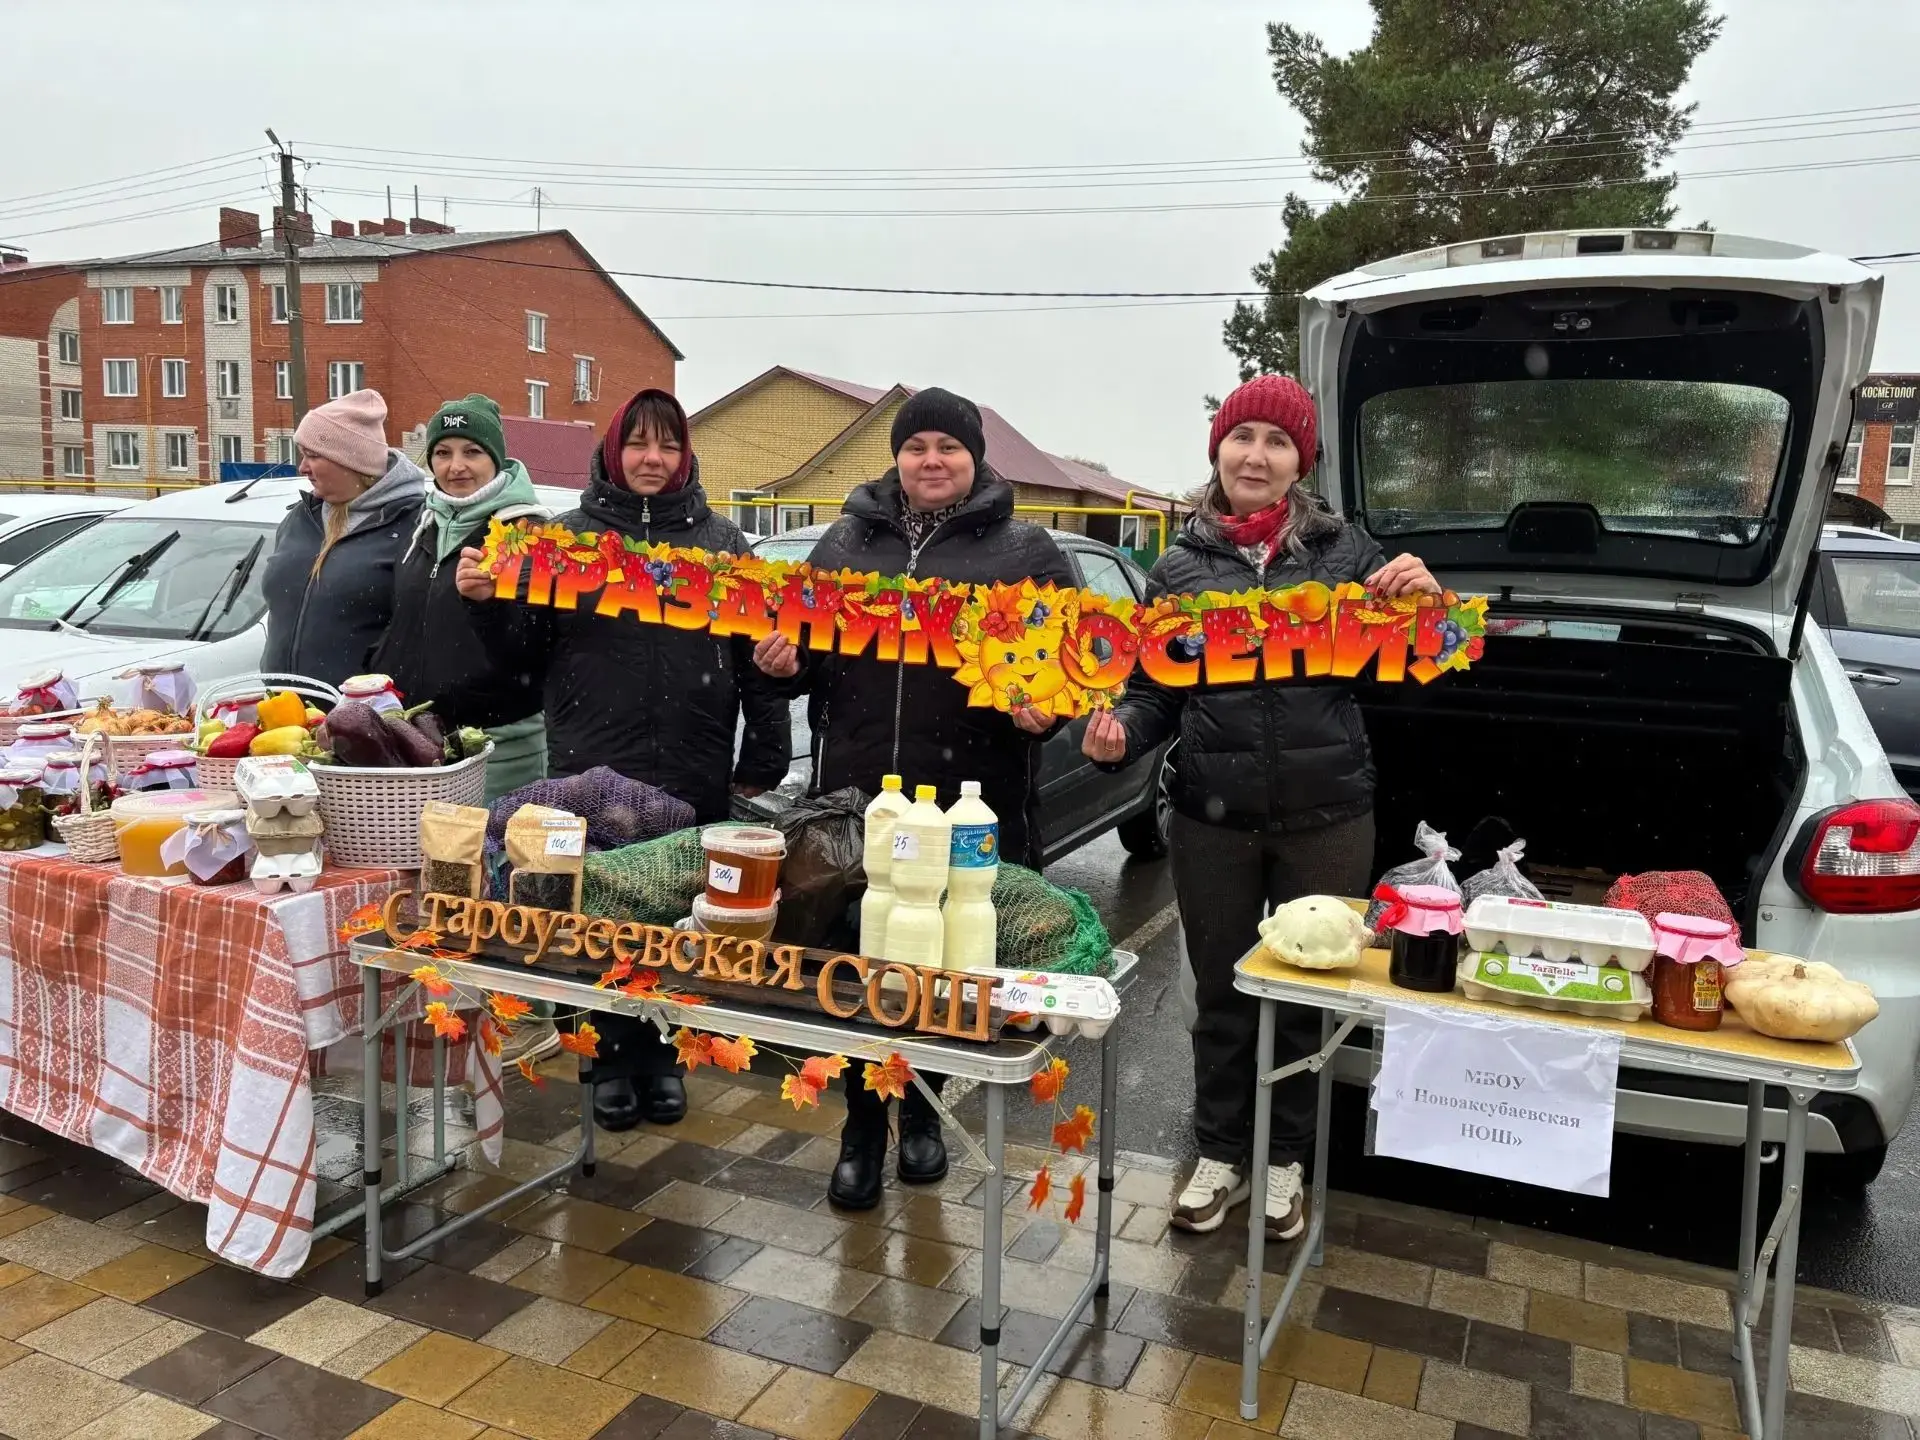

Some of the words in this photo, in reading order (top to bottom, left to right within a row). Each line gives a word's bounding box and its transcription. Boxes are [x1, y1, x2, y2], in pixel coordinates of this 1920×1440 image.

[1861, 386, 1918, 399] КОСМЕТОЛОГ
[494, 533, 967, 669] ПРАЗДНИК
[1060, 597, 1450, 690] ОСЕНИ!
[551, 837, 567, 849] 100
[893, 834, 909, 851] 75
[382, 889, 807, 990] Староузеевская
[817, 954, 1004, 1043] СОШ
[1006, 986, 1028, 1004] 100
[1464, 1068, 1526, 1090] МБОУ
[1414, 1087, 1581, 1129] Новоаксубаевская
[1460, 1122, 1523, 1147] НОШ»
